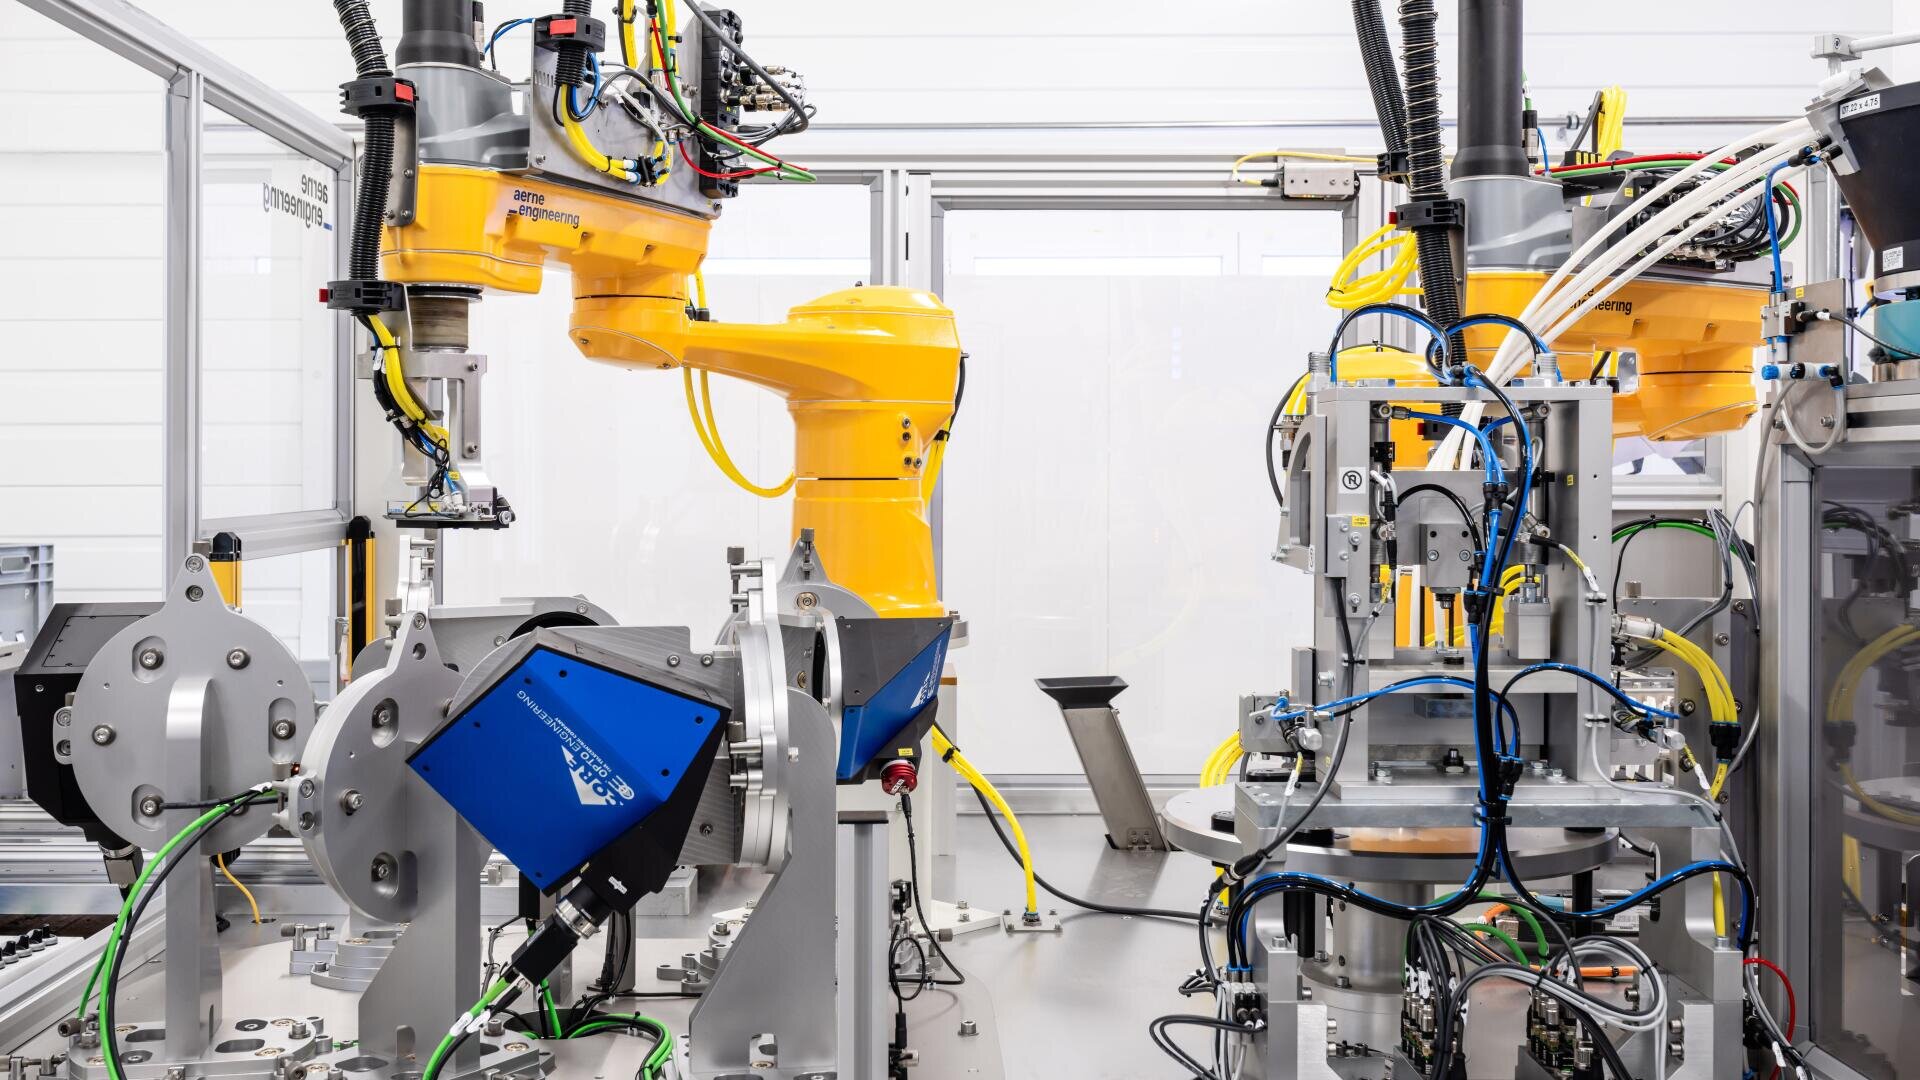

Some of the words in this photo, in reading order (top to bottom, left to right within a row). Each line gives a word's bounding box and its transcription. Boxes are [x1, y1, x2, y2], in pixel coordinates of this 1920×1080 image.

[514, 189, 545, 205] aerne
[518, 204, 580, 229] engineering
[516, 690, 582, 752] ENGINEERING
[554, 716, 577, 739] COMPANY
[575, 737, 604, 765] TELECENTRIC
[580, 751, 608, 778] OPTO
[602, 763, 612, 773] THE
